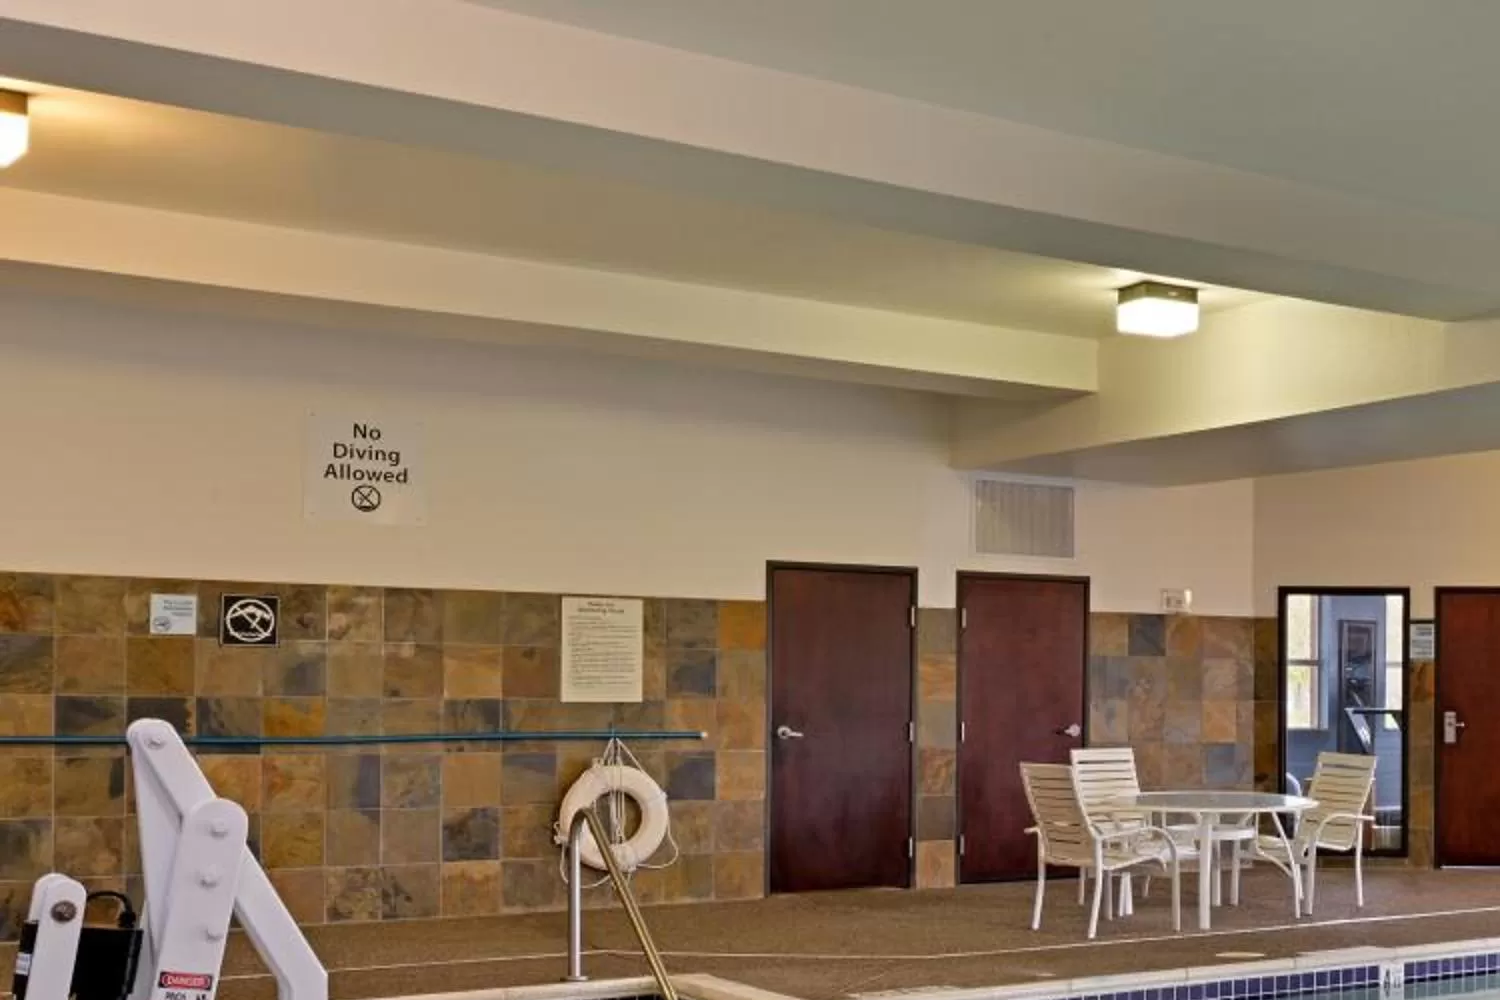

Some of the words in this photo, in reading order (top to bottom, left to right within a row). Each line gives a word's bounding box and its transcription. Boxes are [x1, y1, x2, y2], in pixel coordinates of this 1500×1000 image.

[353, 423, 381, 440] No
[333, 442, 400, 467] Diving
[323, 463, 408, 483] Allowed
[166, 975, 206, 987] DANGER
